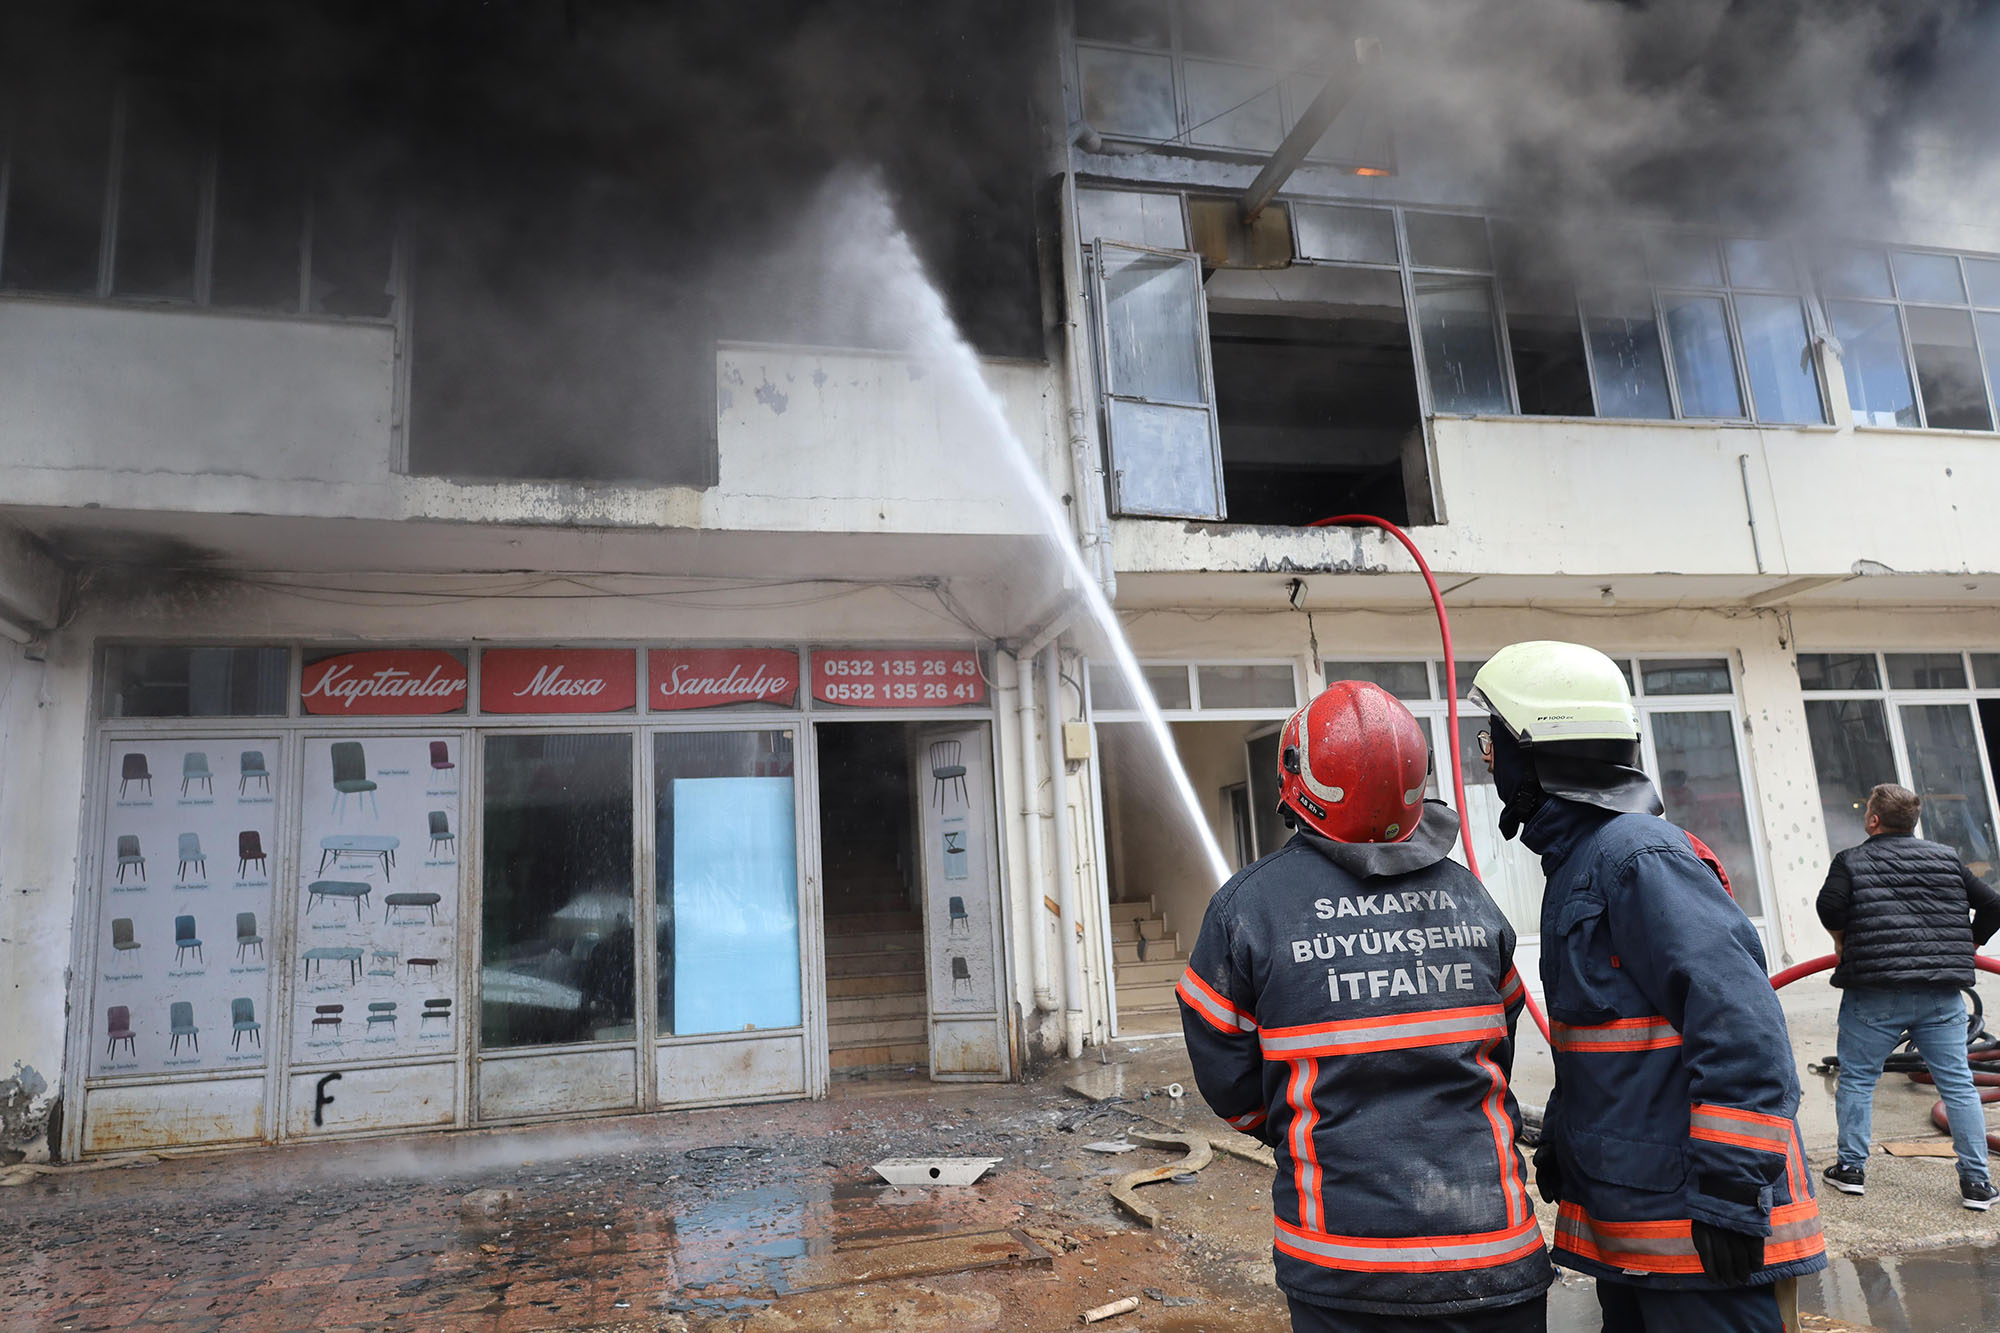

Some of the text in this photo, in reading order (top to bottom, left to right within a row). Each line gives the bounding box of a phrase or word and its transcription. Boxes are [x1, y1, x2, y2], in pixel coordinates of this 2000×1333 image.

[301, 663, 790, 708] Kaptanlar Masa Sandalye
[824, 660, 976, 676] 0532 135 26 43
[825, 683, 976, 700] 0532 135 26 41
[1314, 890, 1457, 920] SAKARYA
[1291, 920, 1488, 963] BÜYÜKŞEHİR
[1327, 960, 1474, 1002] İTFAİYE
